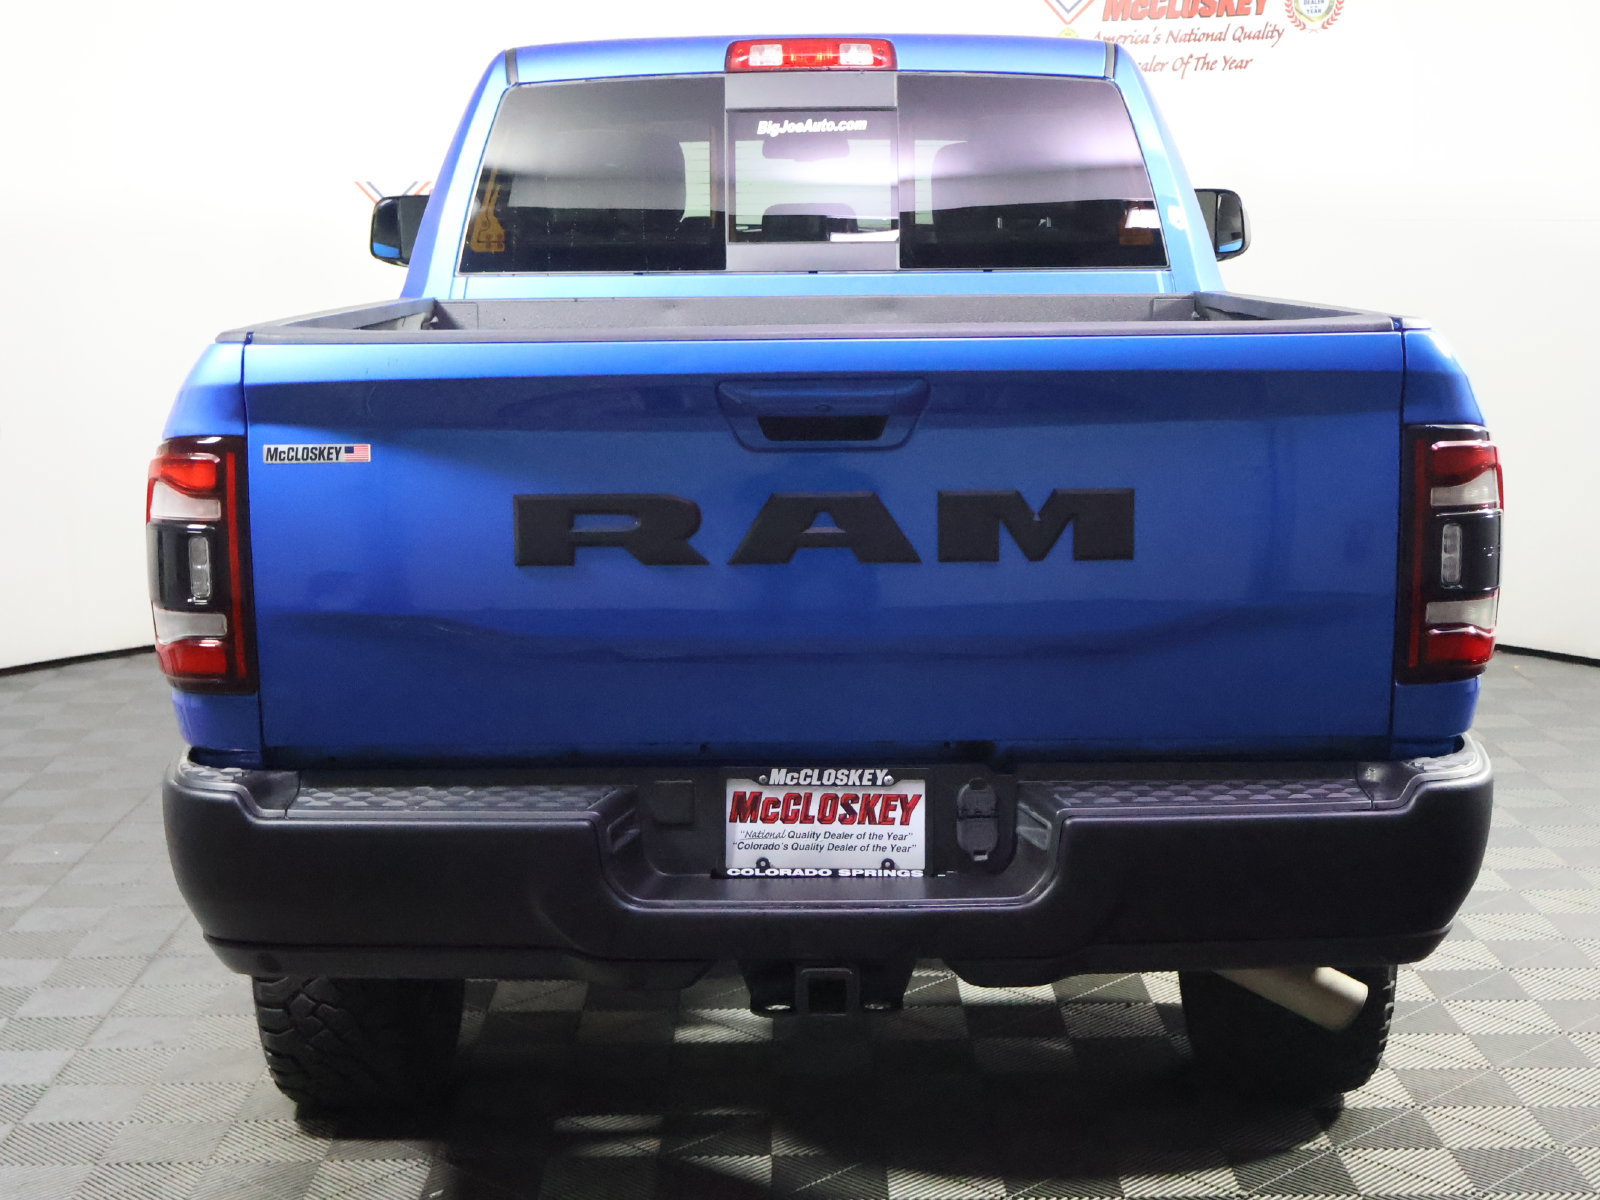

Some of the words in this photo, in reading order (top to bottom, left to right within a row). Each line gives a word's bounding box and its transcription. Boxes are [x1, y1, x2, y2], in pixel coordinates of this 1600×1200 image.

[1165, 23, 1231, 44] National
[1232, 22, 1285, 48] Quality
[1171, 54, 1194, 80] Of
[1194, 53, 1218, 71] The
[1222, 56, 1254, 71] Year
[757, 119, 868, 137] BigJoeAuto.com
[265, 446, 342, 462] McCLOSKEY
[513, 488, 1135, 567] RAM
[769, 768, 889, 786] McCLOSKEY
[729, 791, 922, 826] McCLOSKEY
[787, 831, 821, 841] Quality
[823, 831, 854, 840] Dealer
[856, 832, 868, 840] of
[868, 832, 884, 840] the
[791, 842, 825, 853] Quality
[827, 842, 858, 852] Dealer
[859, 844, 871, 852] of
[872, 844, 887, 852] the
[726, 868, 832, 877] COLORADO
[838, 868, 924, 878] SPRINGS
